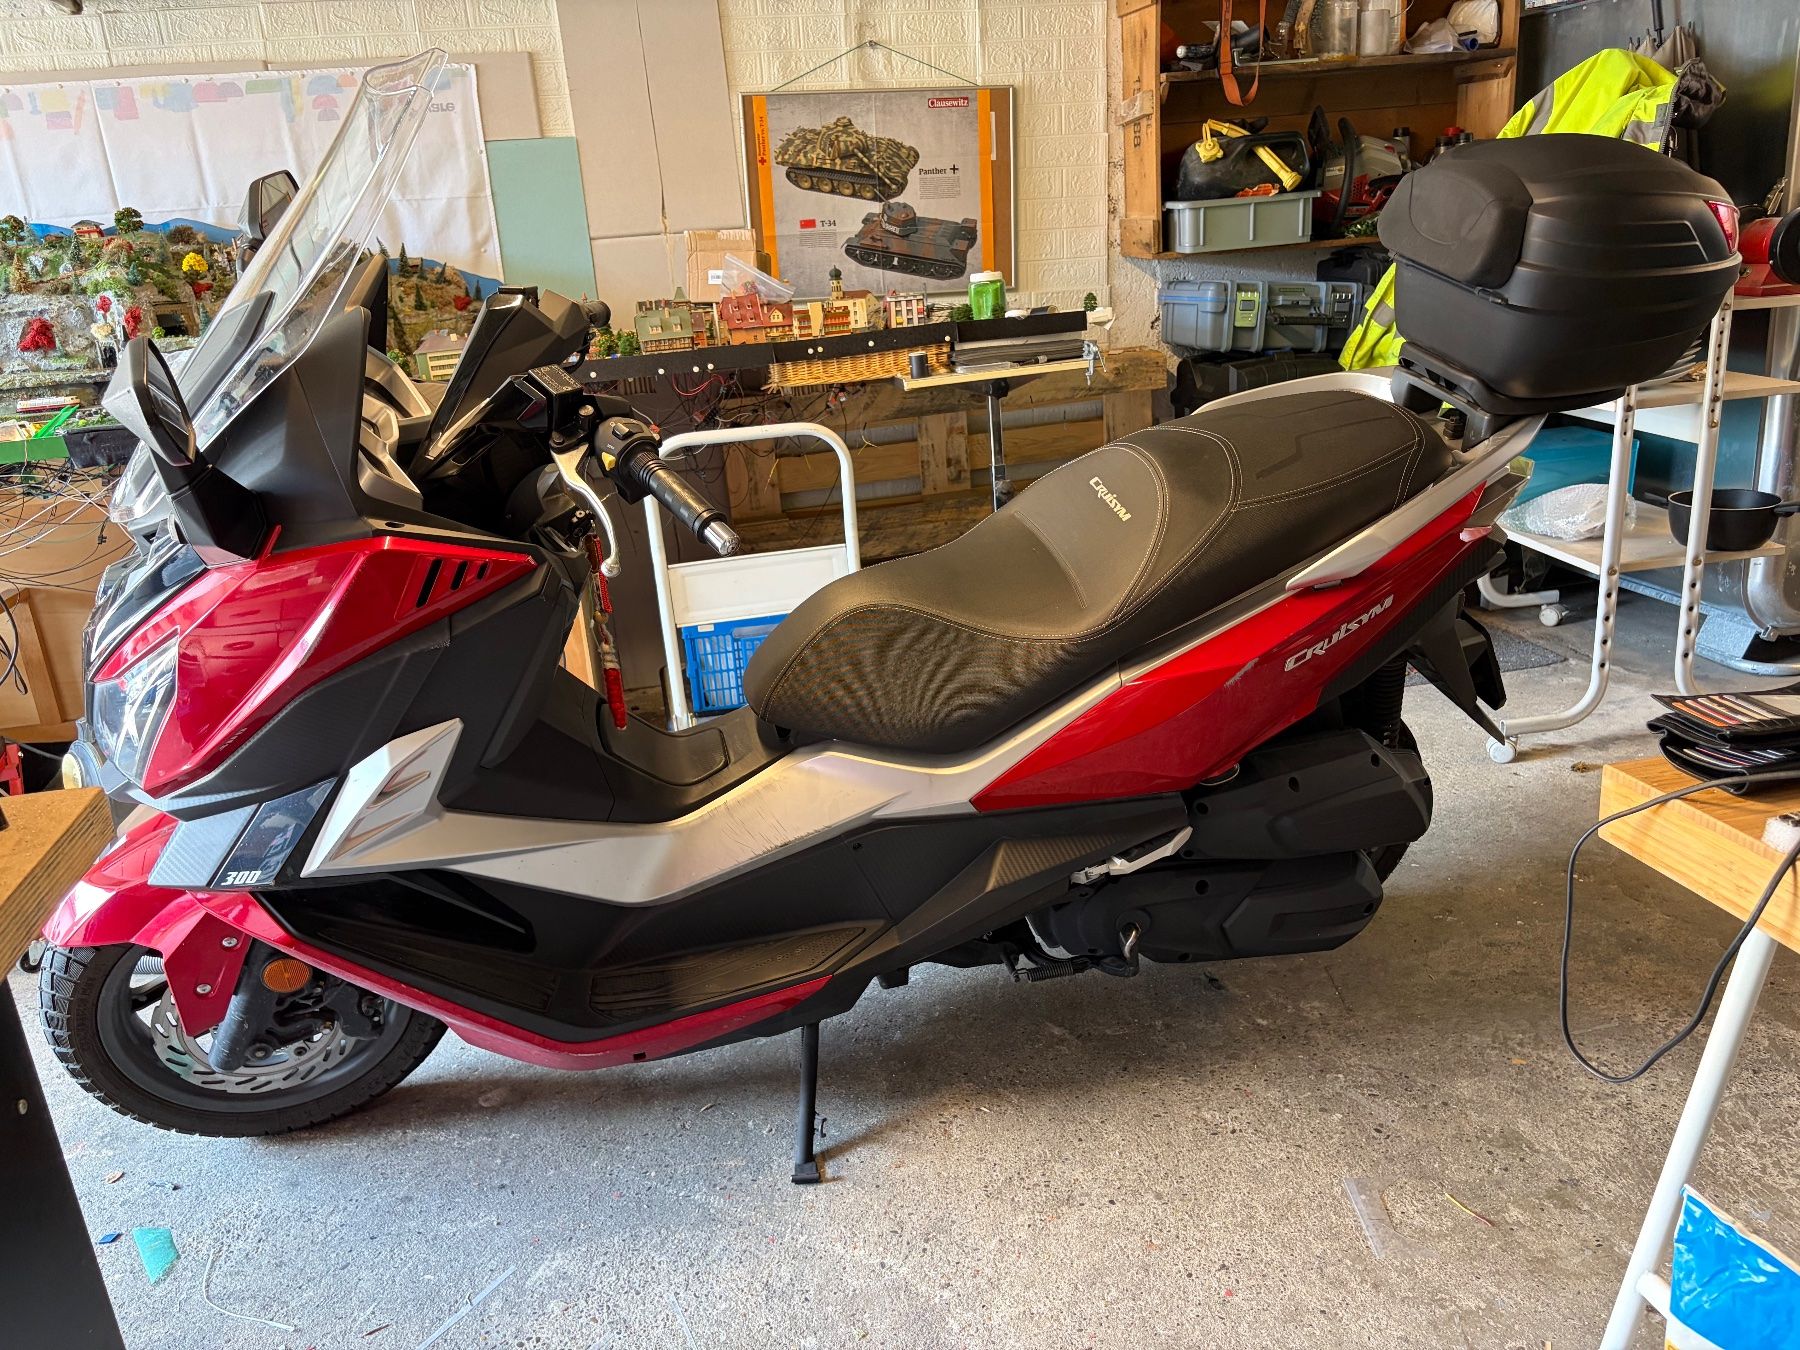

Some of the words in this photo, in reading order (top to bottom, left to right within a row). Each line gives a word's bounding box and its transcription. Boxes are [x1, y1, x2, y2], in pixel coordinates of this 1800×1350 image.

[928, 97, 969, 108] Clausewitz
[918, 167, 947, 176] Panther
[221, 870, 262, 886] 300
